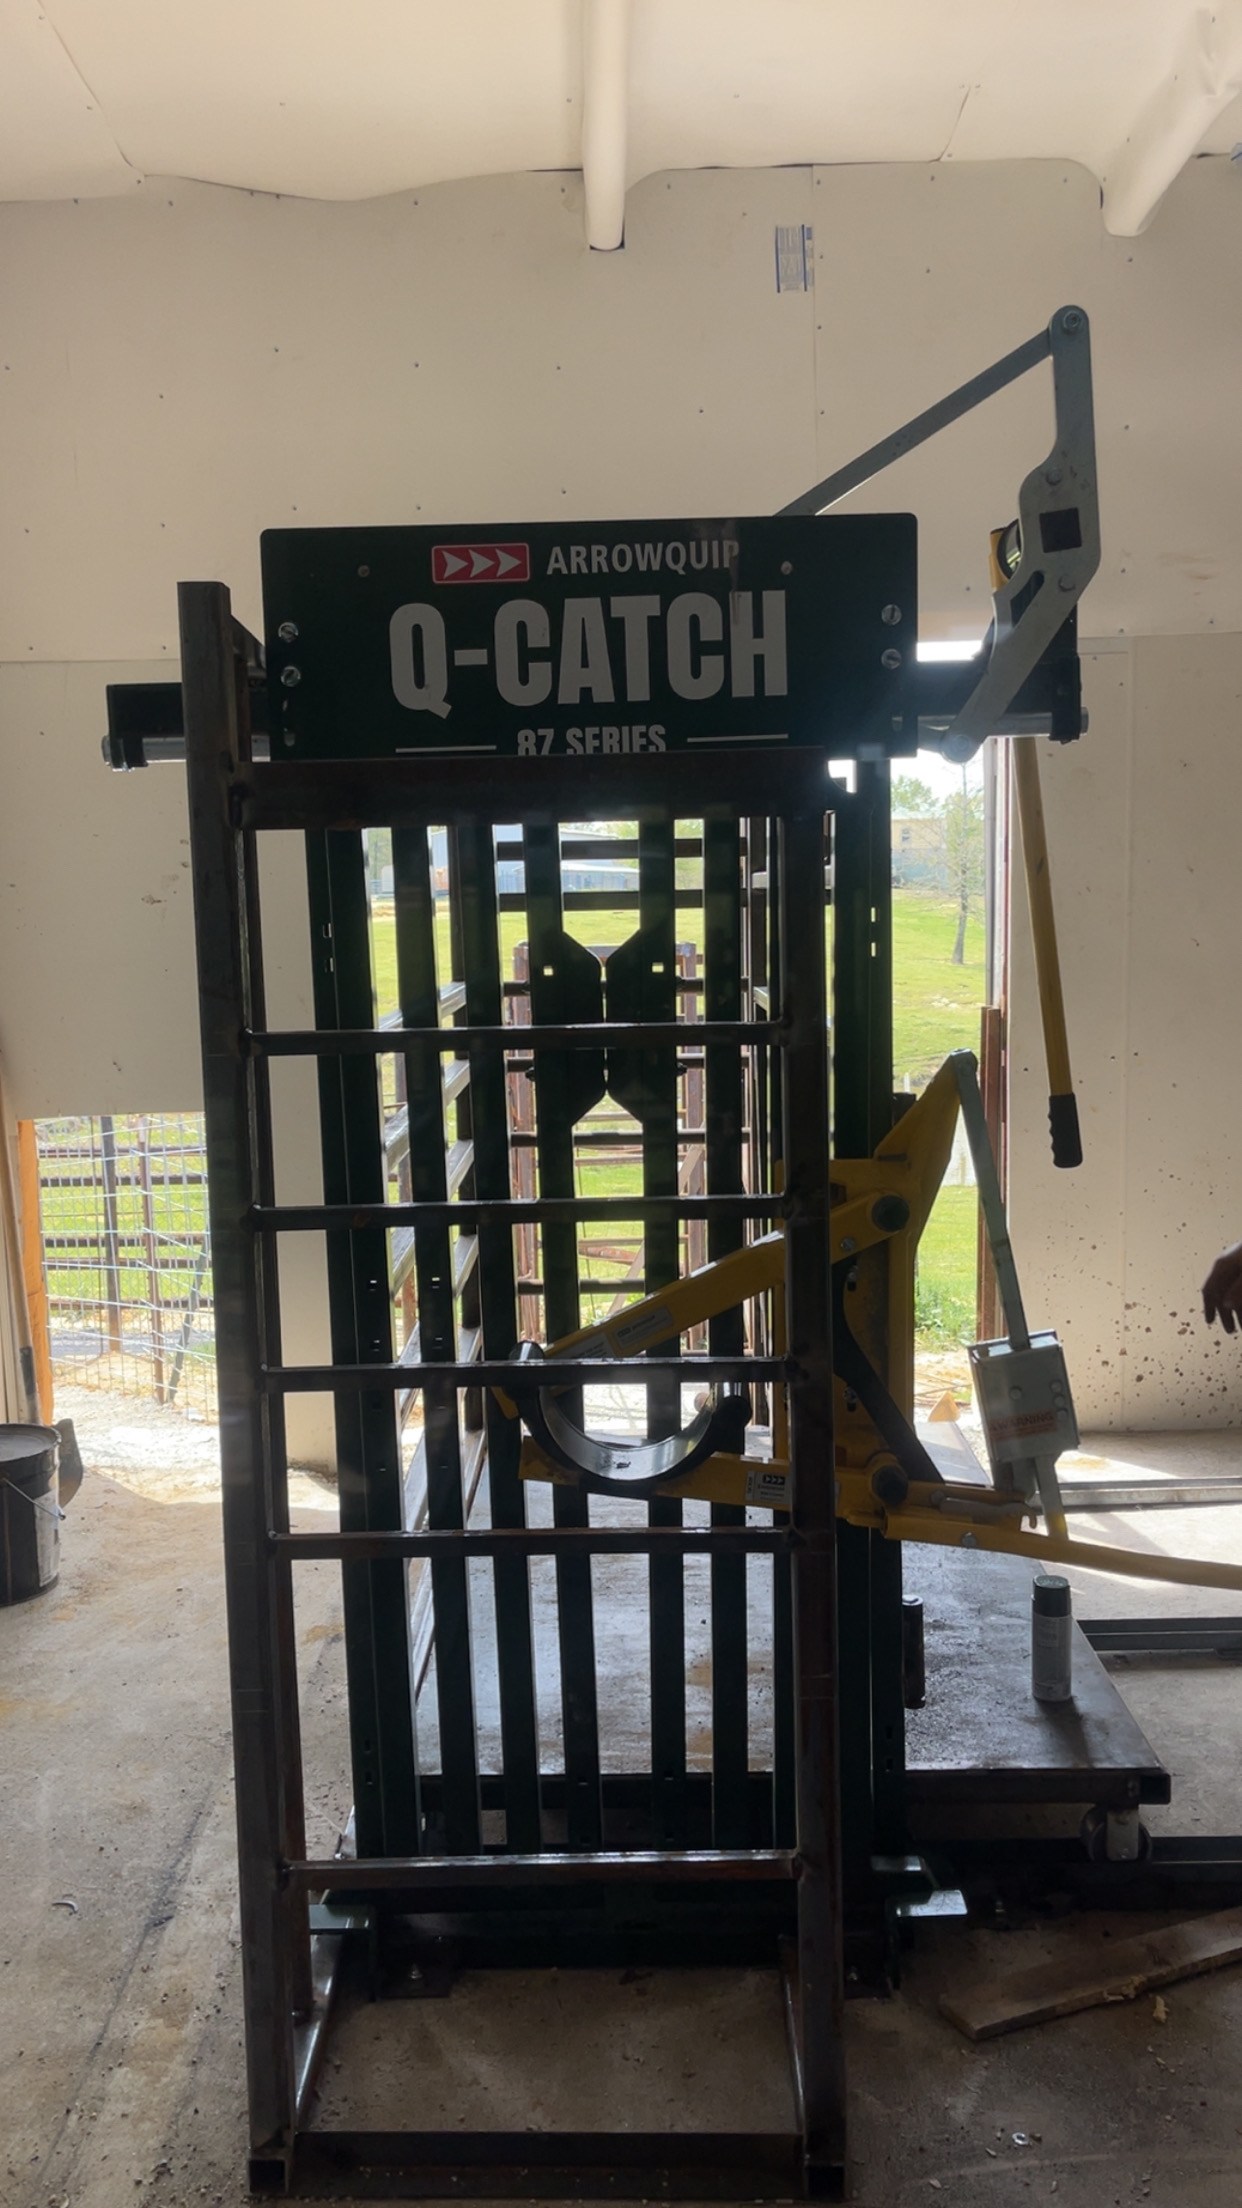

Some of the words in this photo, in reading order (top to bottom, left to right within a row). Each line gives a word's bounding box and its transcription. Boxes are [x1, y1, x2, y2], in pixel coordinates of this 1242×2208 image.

[546, 540, 740, 575] ARROWQUIP
[388, 590, 789, 719] Q-CATCH
[517, 728, 555, 756] 87
[565, 724, 667, 756] SERIES
